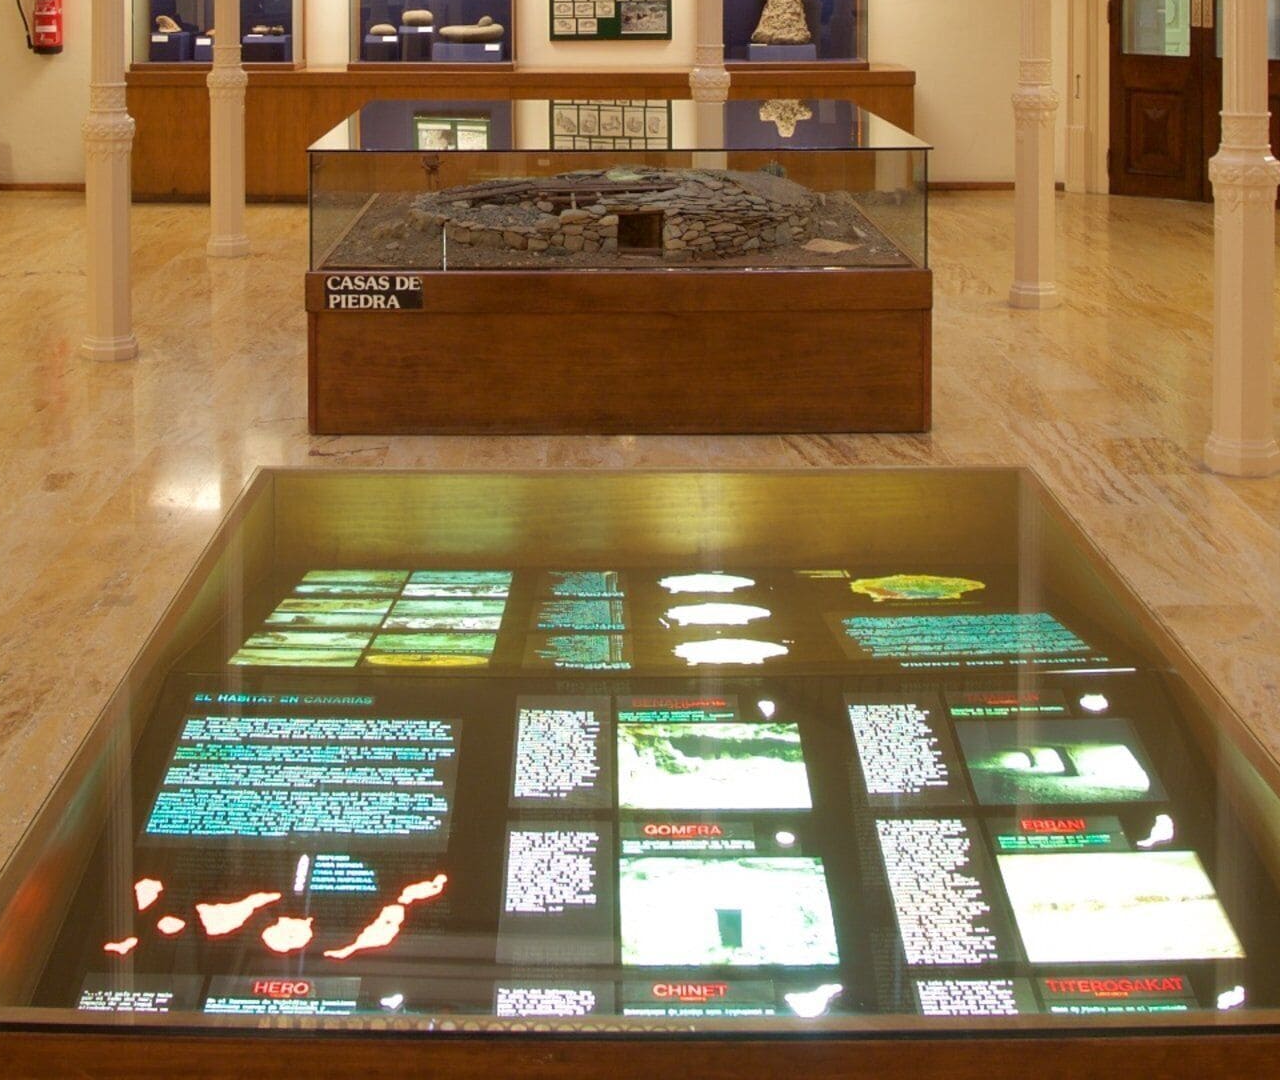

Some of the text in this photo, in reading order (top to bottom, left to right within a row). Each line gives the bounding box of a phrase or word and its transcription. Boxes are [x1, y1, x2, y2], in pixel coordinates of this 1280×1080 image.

[326, 275, 421, 291] CASAS DE
[328, 294, 401, 309] PIEDRA
[194, 694, 374, 705] EL HABITAT EN CANARIAS
[254, 980, 310, 995] HERO
[653, 983, 728, 997] CHINET
[1045, 977, 1183, 993] TITEROGAKAT
